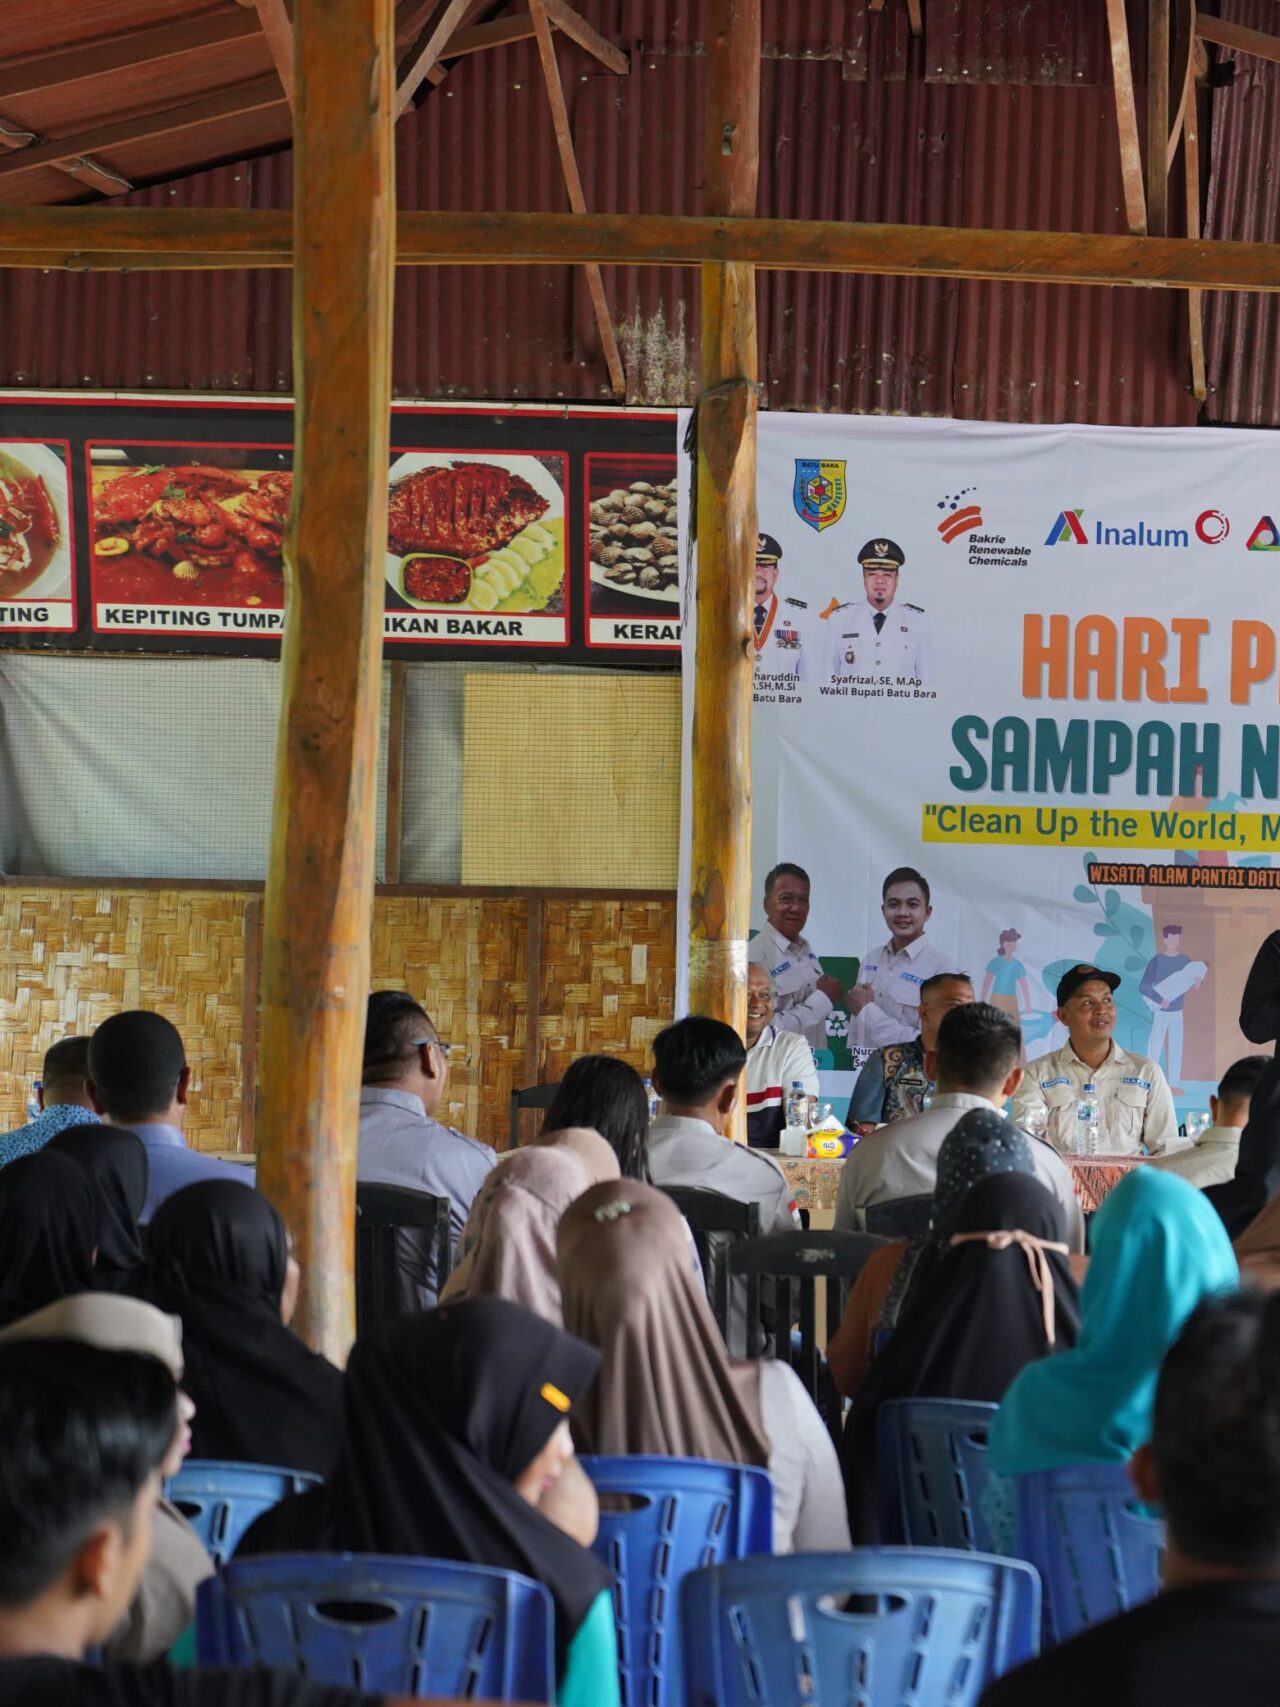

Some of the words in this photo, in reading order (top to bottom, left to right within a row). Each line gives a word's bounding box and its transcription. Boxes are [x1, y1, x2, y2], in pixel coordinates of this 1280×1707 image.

[968, 534, 1006, 544] Bakrie
[1096, 520, 1189, 548] Inalum
[968, 545, 1032, 556] Renewable
[968, 556, 1028, 567] Chemicals
[0, 607, 49, 622] TING
[105, 608, 211, 625] KEPITING
[218, 611, 284, 628] TUMP
[384, 617, 438, 633] IKAN
[446, 618, 523, 636] BAKAR
[1022, 613, 1210, 704] HARI
[755, 672, 800, 682] haruddin
[896, 677, 922, 688] M.Ap
[753, 694, 776, 703] Batu
[779, 695, 802, 704] Bara
[820, 686, 848, 697] Wakil
[851, 687, 884, 699] Bupati
[887, 688, 911, 698] Batu
[913, 689, 937, 699] Bara
[948, 714, 1220, 798] SAMPAH
[924, 805, 1021, 835] "Clean
[1035, 808, 1078, 839] Up
[1090, 809, 1138, 838] the
[1150, 811, 1247, 846] World,
[1090, 865, 1145, 884] WISATA
[1151, 866, 1188, 885] ALAM
[1192, 868, 1244, 886] PANTAI
